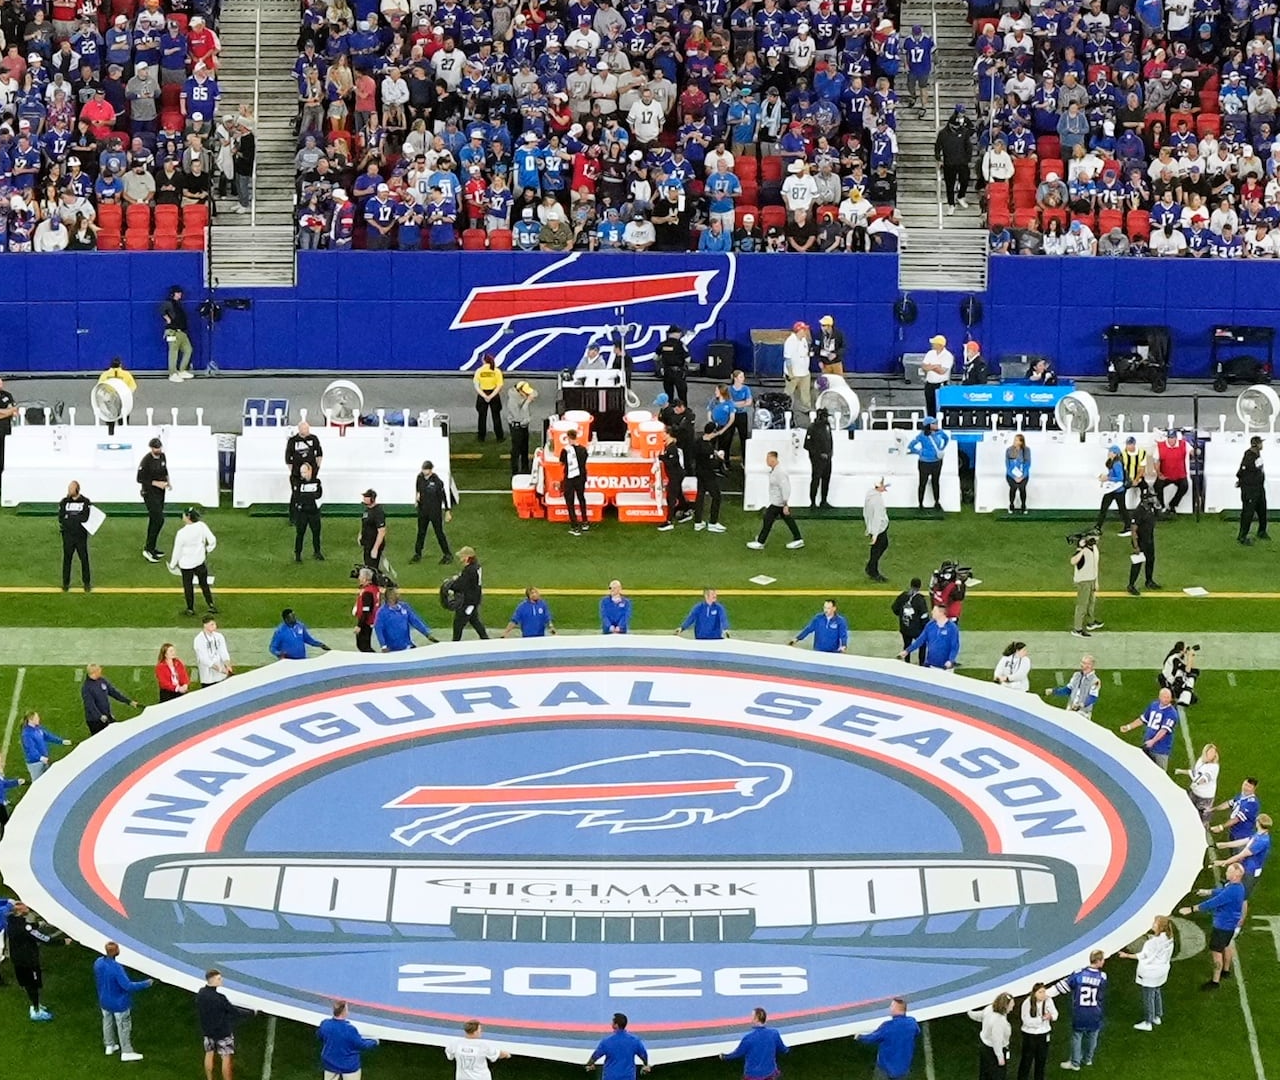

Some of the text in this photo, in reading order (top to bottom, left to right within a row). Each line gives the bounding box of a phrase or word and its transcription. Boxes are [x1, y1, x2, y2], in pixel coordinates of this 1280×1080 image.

[818, 24, 832, 37] 55
[82, 41, 96, 54] 22
[631, 39, 645, 52] 27
[911, 48, 924, 63] 17
[441, 58, 455, 70] 27
[193, 87, 208, 100] 85
[54, 138, 66, 152] 17
[526, 156, 534, 170] 0
[546, 157, 561, 171] 97
[379, 207, 391, 221] 17
[584, 476, 650, 489] TORADE
[1148, 711, 1162, 730] 12
[123, 681, 691, 838] INAUGURAL
[744, 692, 1087, 838] SEASON
[463, 880, 758, 898] HIGHMARK
[521, 897, 688, 905] STADIUM
[397, 964, 808, 997] 2026
[1080, 986, 1098, 1006] 21
